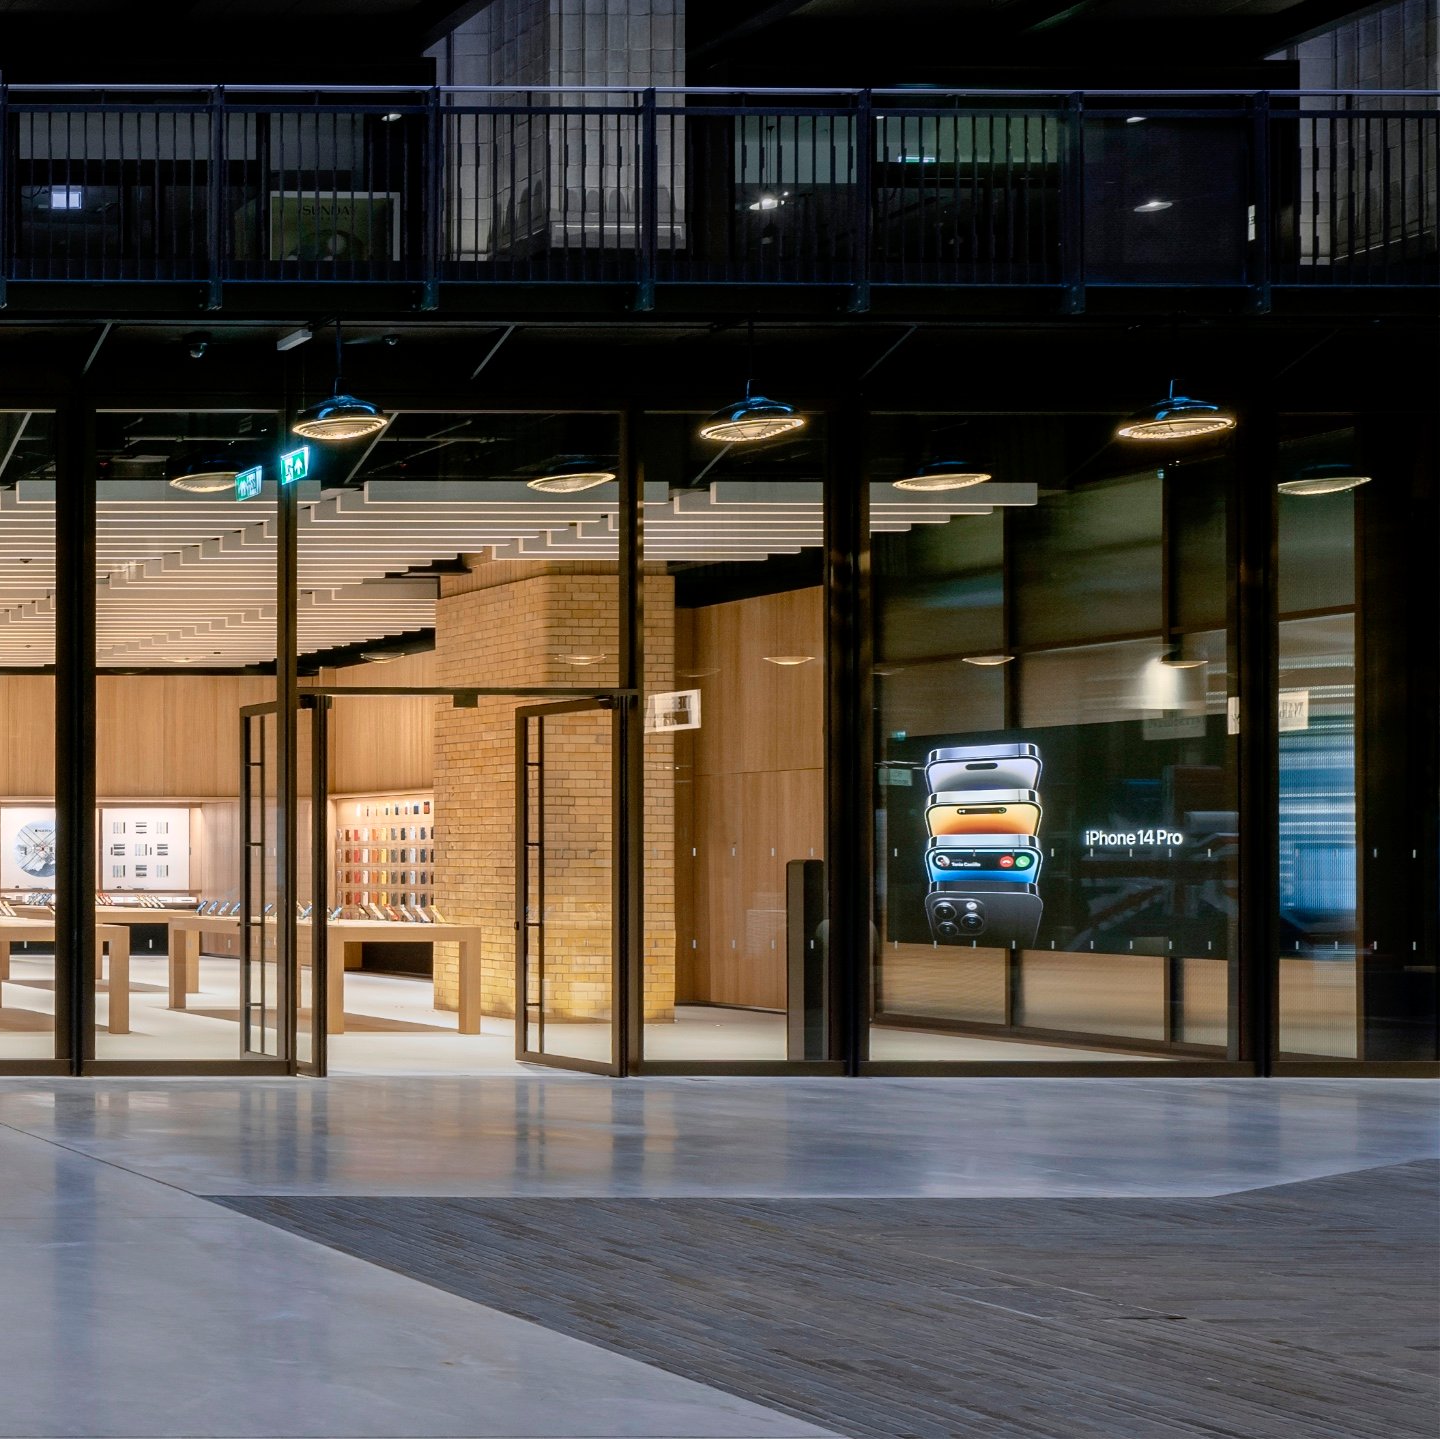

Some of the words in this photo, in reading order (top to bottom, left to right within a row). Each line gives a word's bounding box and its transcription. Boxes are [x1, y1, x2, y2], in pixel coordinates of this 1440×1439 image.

[303, 205, 356, 216] SUNDA
[1085, 830, 1136, 846] iPhone
[1137, 829, 1155, 845] 14
[1156, 829, 1184, 846] Pro
